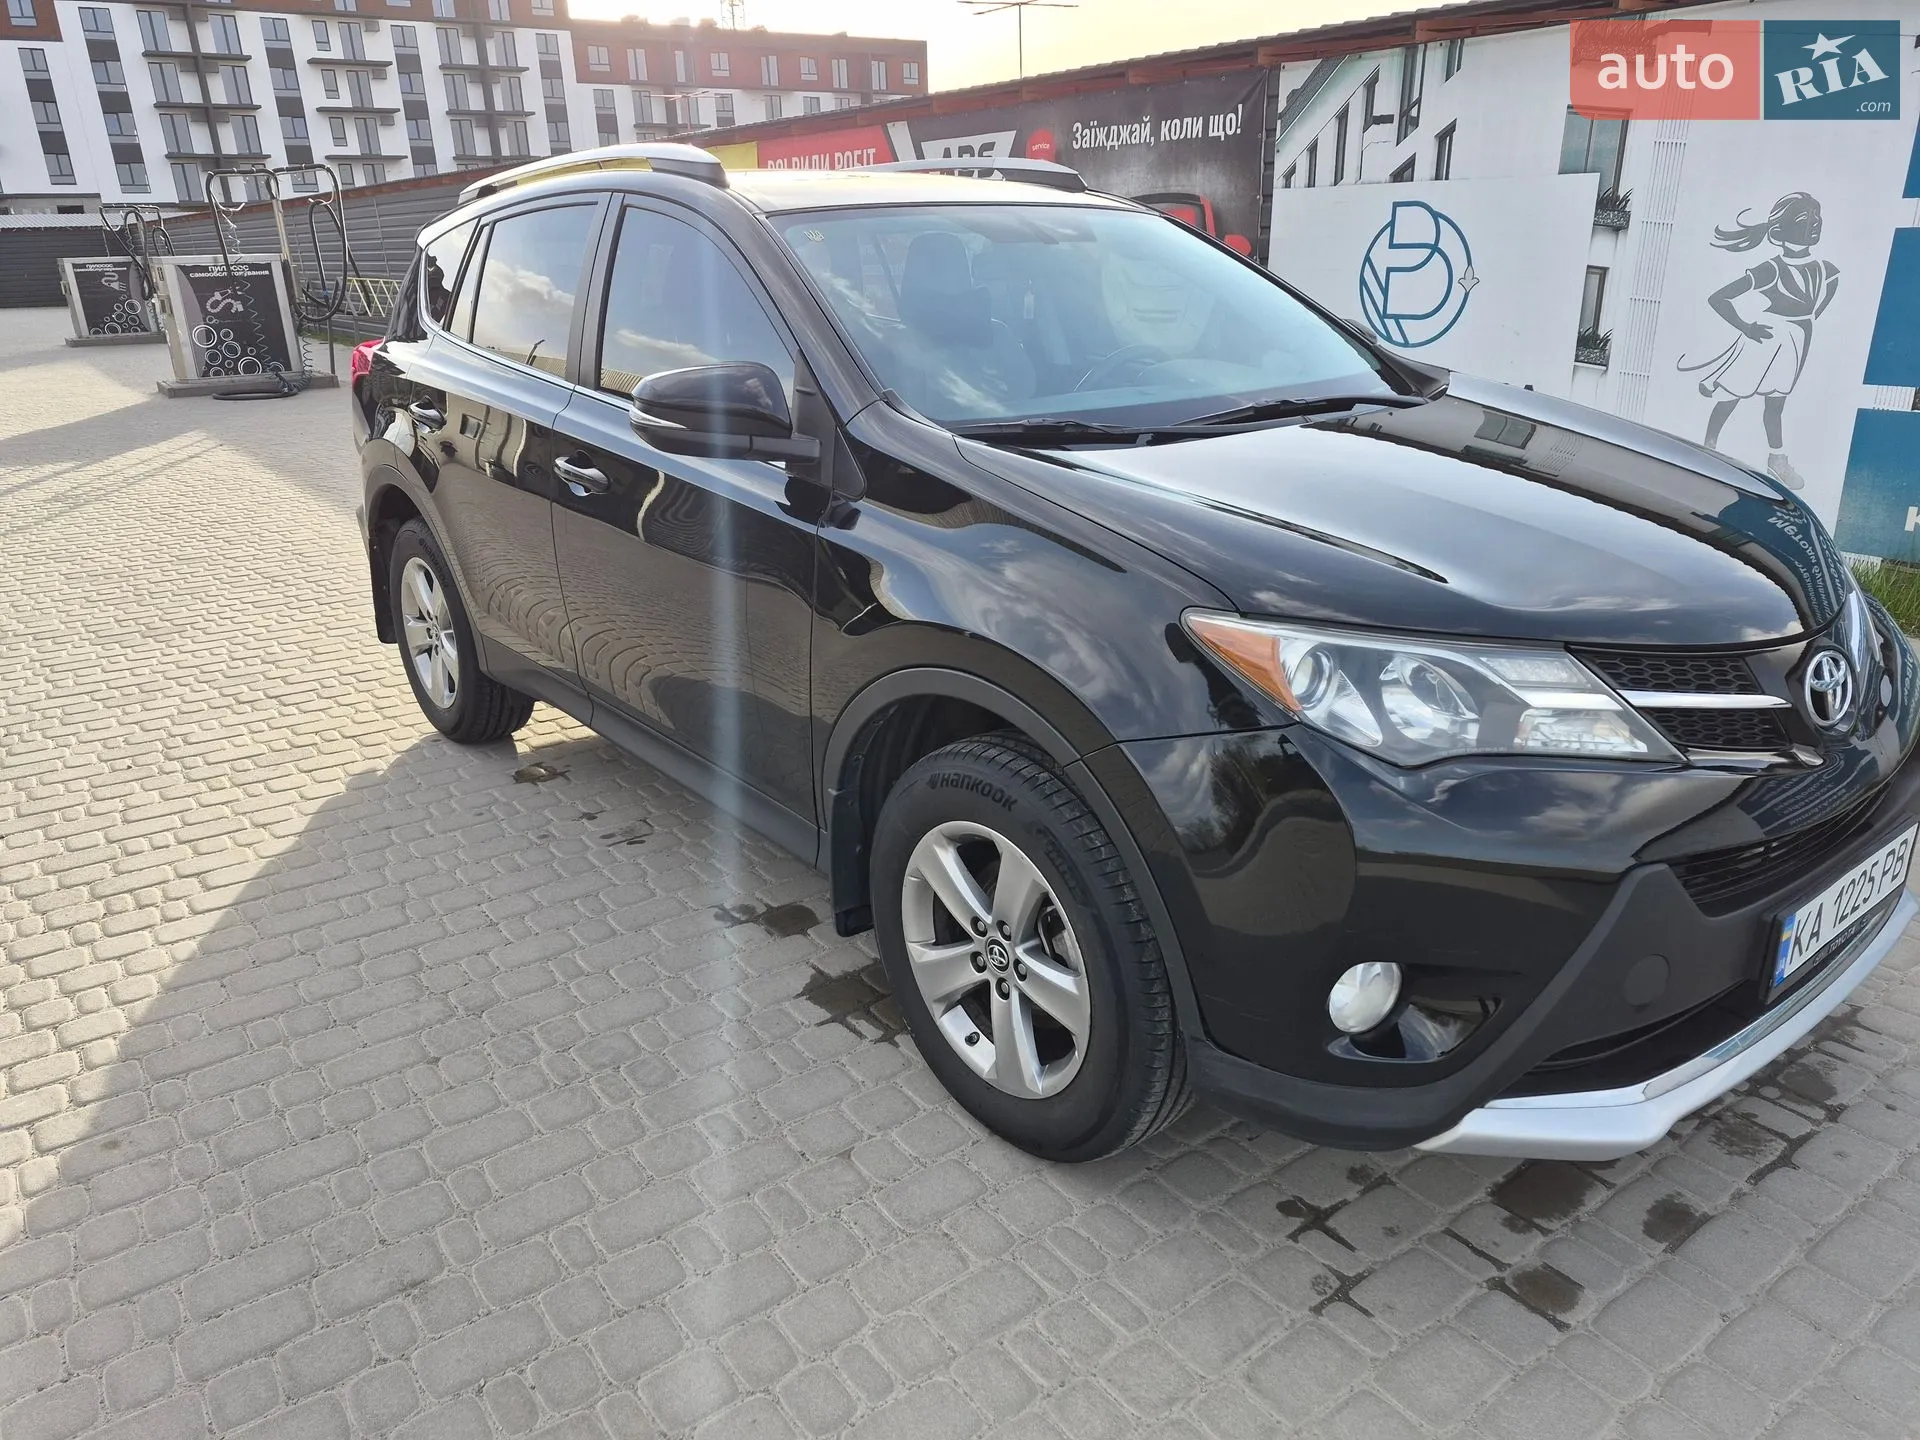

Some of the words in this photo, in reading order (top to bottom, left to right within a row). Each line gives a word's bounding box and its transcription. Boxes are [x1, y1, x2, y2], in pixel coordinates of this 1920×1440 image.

[1072, 115, 1155, 151] Заїжджай,
[1160, 116, 1203, 142] коли
[1208, 104, 1243, 141] що!
[1789, 902, 1824, 966] KA
[1833, 859, 1880, 929] 1225
[1877, 837, 1909, 895] PB
